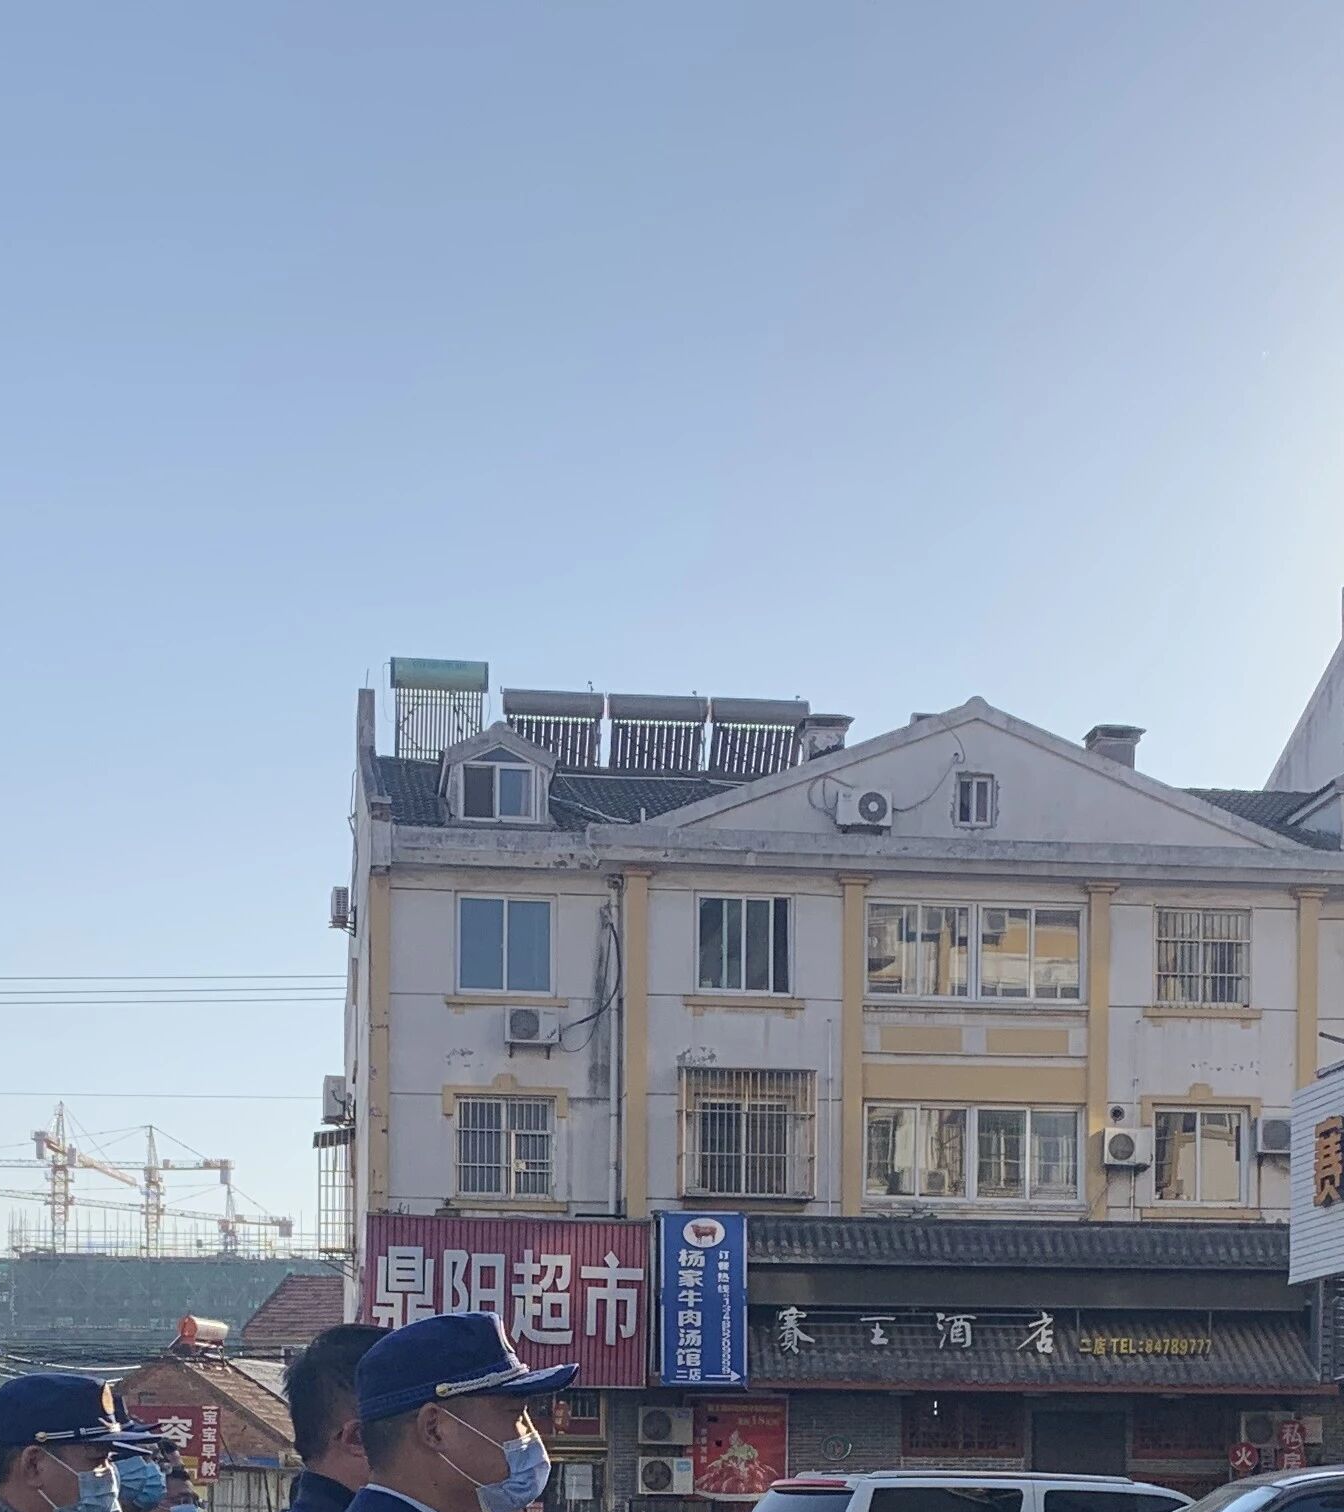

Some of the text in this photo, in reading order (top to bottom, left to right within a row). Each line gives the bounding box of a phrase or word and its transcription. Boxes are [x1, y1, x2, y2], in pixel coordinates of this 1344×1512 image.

[372, 1246, 644, 1346] 鼎阳超市
[676, 1249, 705, 1366] 杨家牛肉汤馆
[1078, 1337, 1213, 1357] 二店 TEL:84789777
[676, 1369, 702, 1381] 二店
[1234, 1449, 1253, 1467] 火
